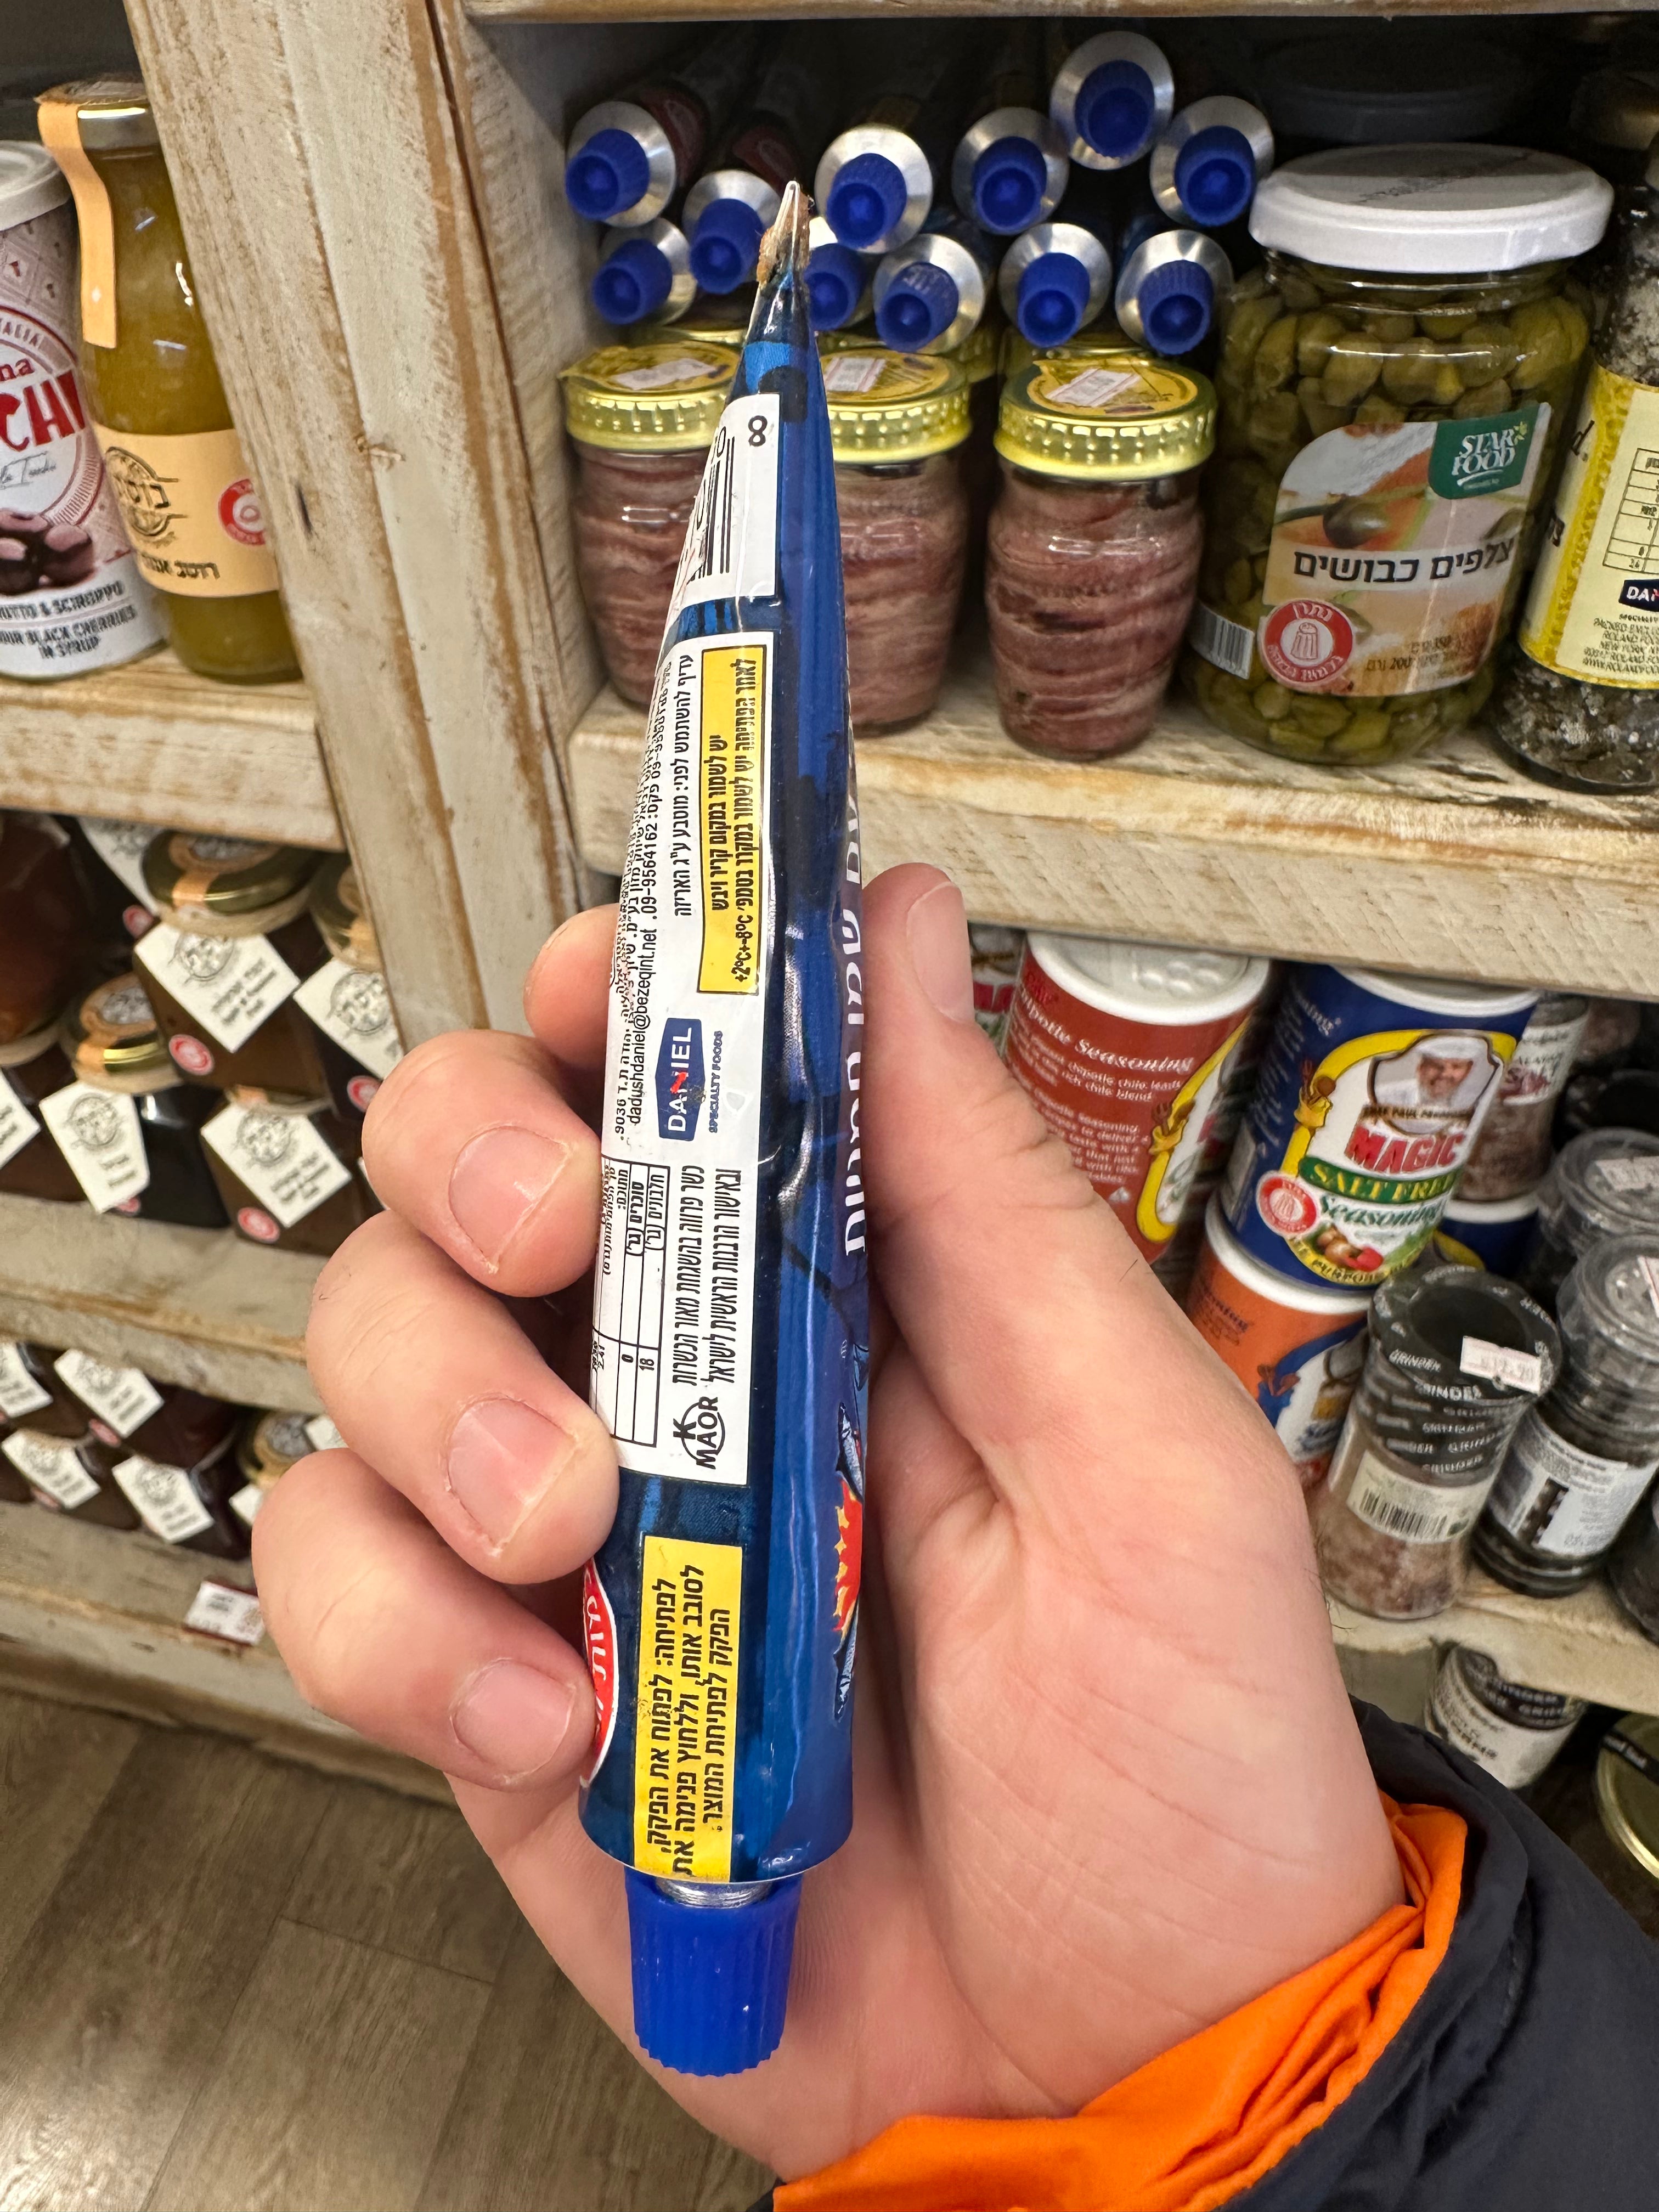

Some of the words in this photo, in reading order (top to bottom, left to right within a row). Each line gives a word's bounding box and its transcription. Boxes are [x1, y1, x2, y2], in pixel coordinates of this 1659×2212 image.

[748, 415, 768, 447] 8
[1459, 428, 1515, 459] STAR
[1451, 447, 1516, 476] FOOD
[1294, 551, 1420, 583] כבושים
[1429, 537, 1514, 580] צלפים
[678, 654, 696, 686] עדיף
[730, 659, 757, 695] לאחר
[673, 691, 691, 753] להשתמש
[709, 735, 728, 752] יש
[735, 755, 755, 772] יש
[670, 758, 690, 791] לפני:
[703, 755, 728, 797] לשמור
[729, 776, 754, 820] לשמור
[708, 802, 731, 844] במקום
[734, 823, 760, 864] במקרר
[709, 850, 733, 878] קריר
[672, 870, 692, 916] האריזה
[711, 881, 729, 911] ויבש
[712, 1030, 723, 1070] FOODS
[1074, 1039, 1194, 1074] Seasoning
[667, 1027, 692, 1132] DANIEL
[708, 1073, 721, 1133] SPECIALTY
[1344, 1124, 1466, 1174] MAGIC
[616, 1169, 628, 1210] מתוכם:
[646, 1174, 665, 1220] חלבונים
[680, 1165, 704, 1192] כשר
[713, 1168, 742, 1220] ובאישור
[629, 1181, 644, 1223] סוכרים
[679, 1198, 703, 1233] פרווה
[676, 1237, 702, 1294] בהשגחת
[712, 1225, 740, 1273] הרבנות
[674, 1297, 701, 1329] מאור
[709, 1276, 738, 1332] הראשית
[638, 1358, 655, 1371] 18
[672, 1334, 699, 1386] הכשרות
[700, 1334, 736, 1384] לישראל
[673, 1418, 697, 1440] K
[696, 1396, 718, 1470] MAOR
[679, 1565, 704, 1627] לסובב
[651, 1578, 676, 1666] לפתיחה:
[708, 1609, 733, 1667] הפקק
[680, 1633, 702, 1679] אותו
[647, 1674, 673, 1741] לפתוח
[672, 1693, 701, 1763] וללחוץ
[695, 1672, 727, 1757] לפתיחת
[650, 1747, 670, 1780] את
[675, 1771, 697, 1832] פנימה
[702, 1763, 724, 1832] המוצר.
[647, 1786, 672, 1854] הפקק,
[672, 1840, 695, 1876] את
